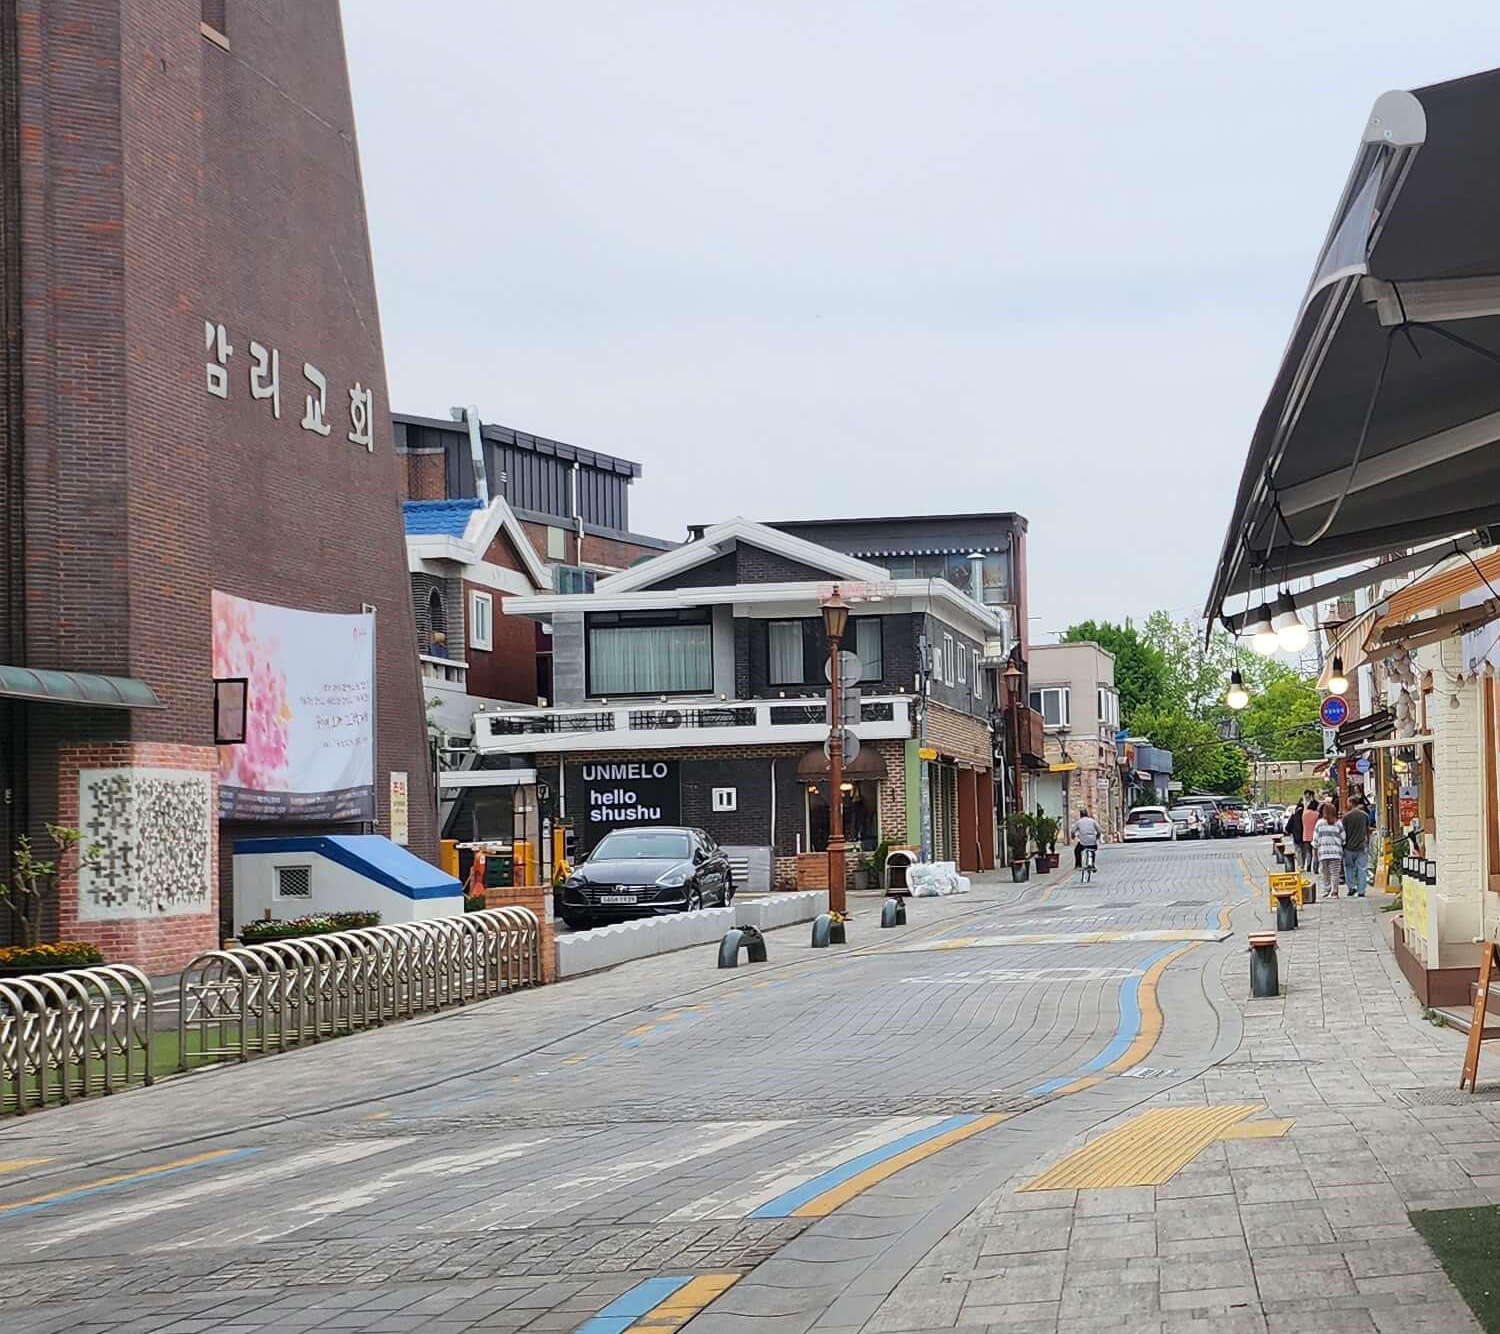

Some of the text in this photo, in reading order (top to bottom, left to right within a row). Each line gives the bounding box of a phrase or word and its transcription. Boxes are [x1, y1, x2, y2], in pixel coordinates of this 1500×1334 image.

[205, 320, 373, 453] 감리교회
[582, 763, 668, 781] UNMELO
[590, 788, 637, 805] hello
[590, 805, 661, 821] shushu
